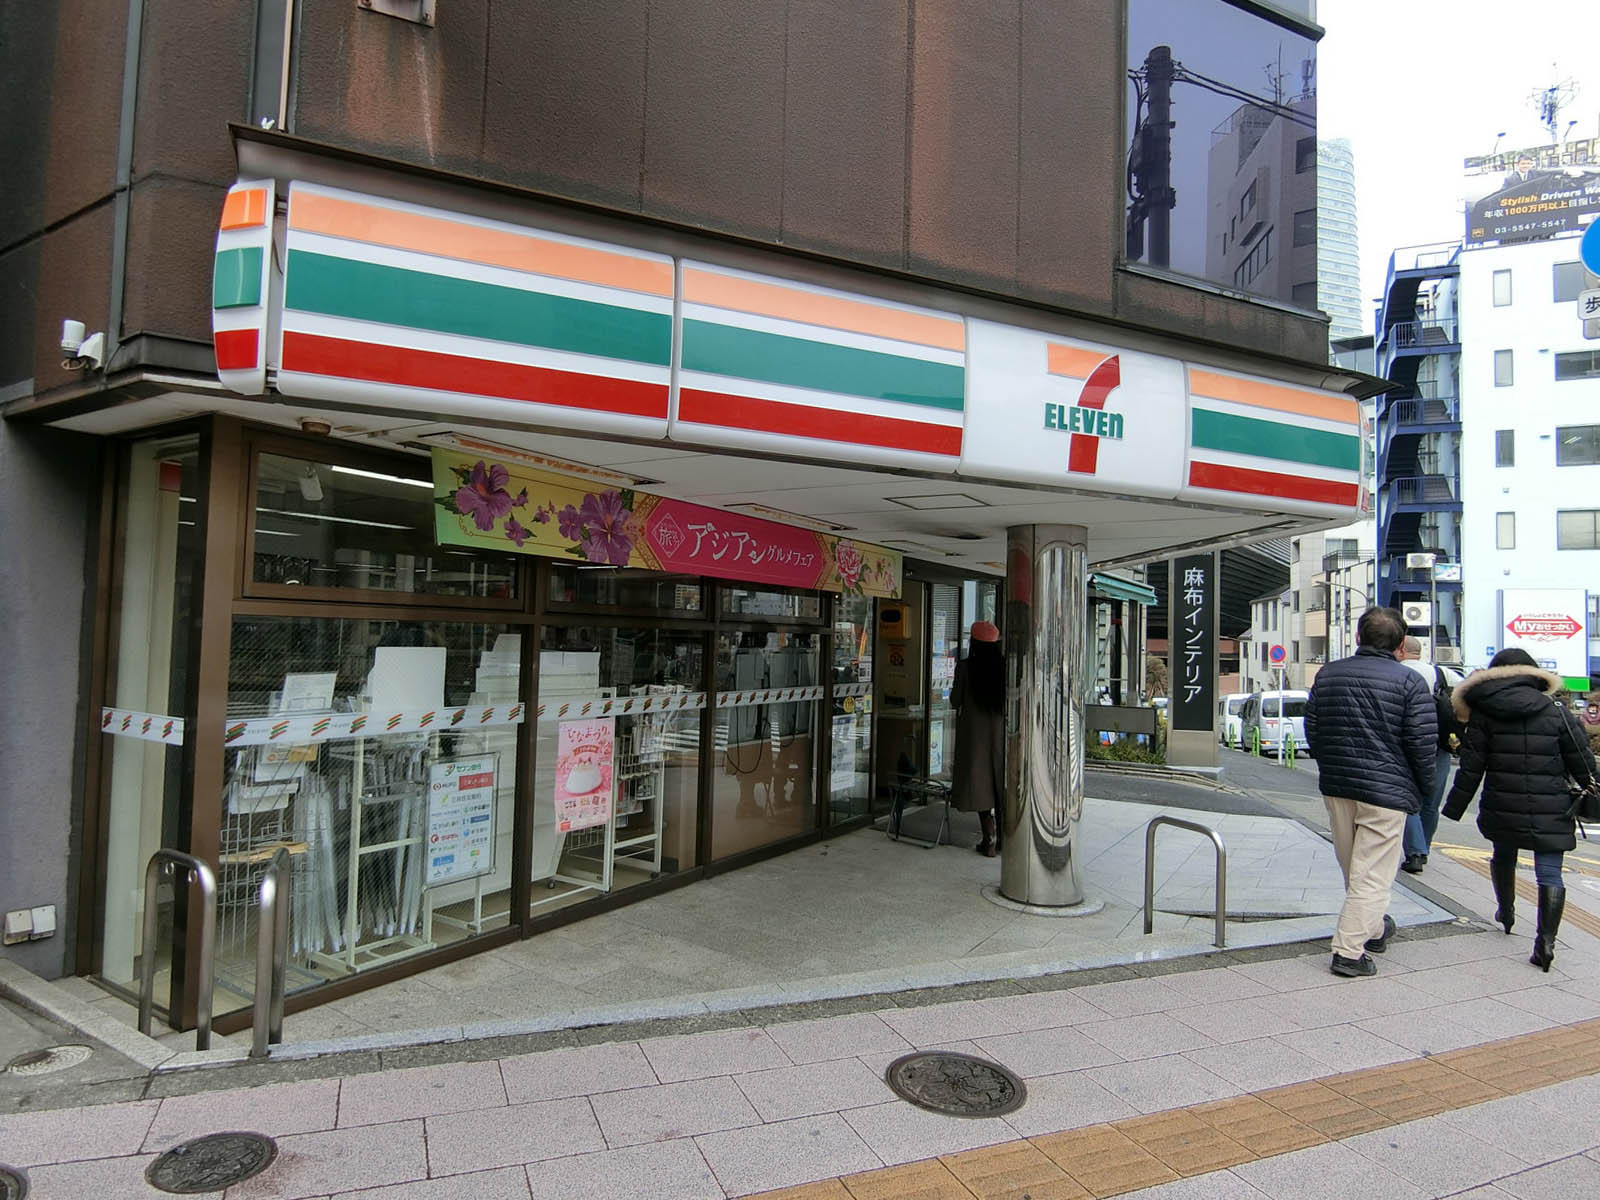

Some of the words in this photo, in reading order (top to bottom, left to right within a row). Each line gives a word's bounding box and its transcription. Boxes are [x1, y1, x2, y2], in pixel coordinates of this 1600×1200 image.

[1500, 194, 1538, 207] Stylish
[1540, 189, 1582, 201] Drivers
[1183, 567, 1205, 703] 麻布インテリア
